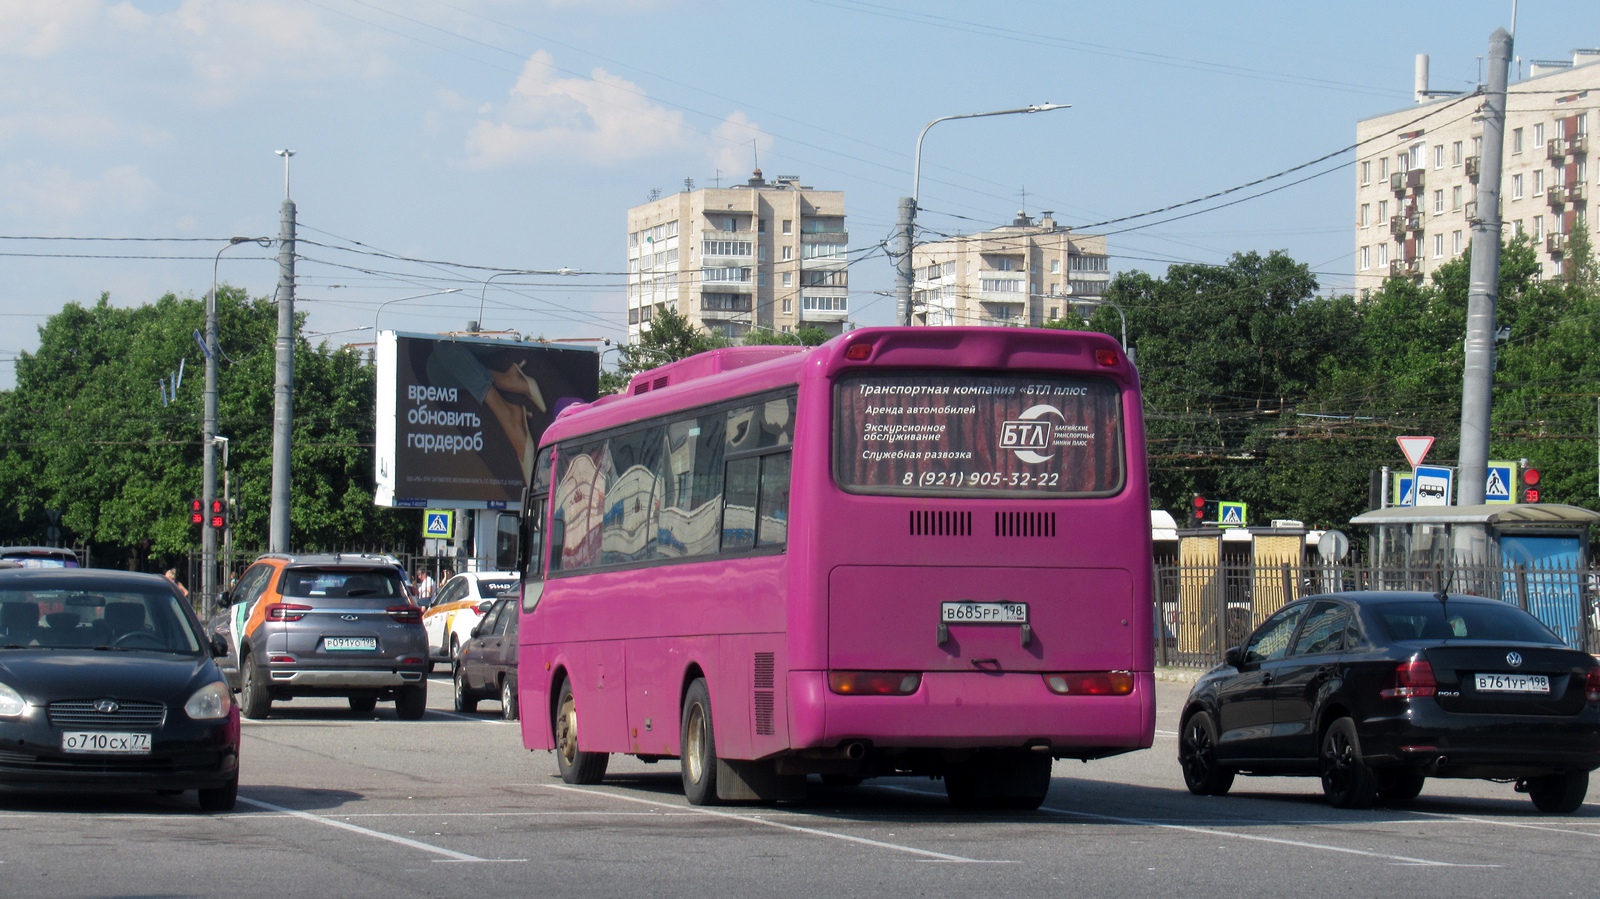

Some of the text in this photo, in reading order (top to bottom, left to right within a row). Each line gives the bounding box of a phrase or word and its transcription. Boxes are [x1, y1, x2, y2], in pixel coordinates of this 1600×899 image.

[408, 384, 457, 404] время
[859, 384, 1088, 396] Транспортная компания «БТЛ плюс
[408, 405, 481, 427] обновить
[865, 405, 976, 416] Аренда автомобилей
[864, 423, 946, 434] Экскурсионное
[1055, 424, 1089, 432] БАЛТИЙСКИЕ
[863, 432, 941, 442] обслуживание
[1003, 425, 1044, 446] БТЛ
[408, 431, 483, 455] гардероб
[862, 450, 972, 461] Служебная развозка
[902, 472, 1060, 488] 8 (921) 905-32-22
[1526, 490, 1538, 503] 39
[947, 605, 1022, 619] В685РР 198
[1479, 675, 1547, 689] В761УР 198
[67, 734, 147, 750] О710СХ 77
